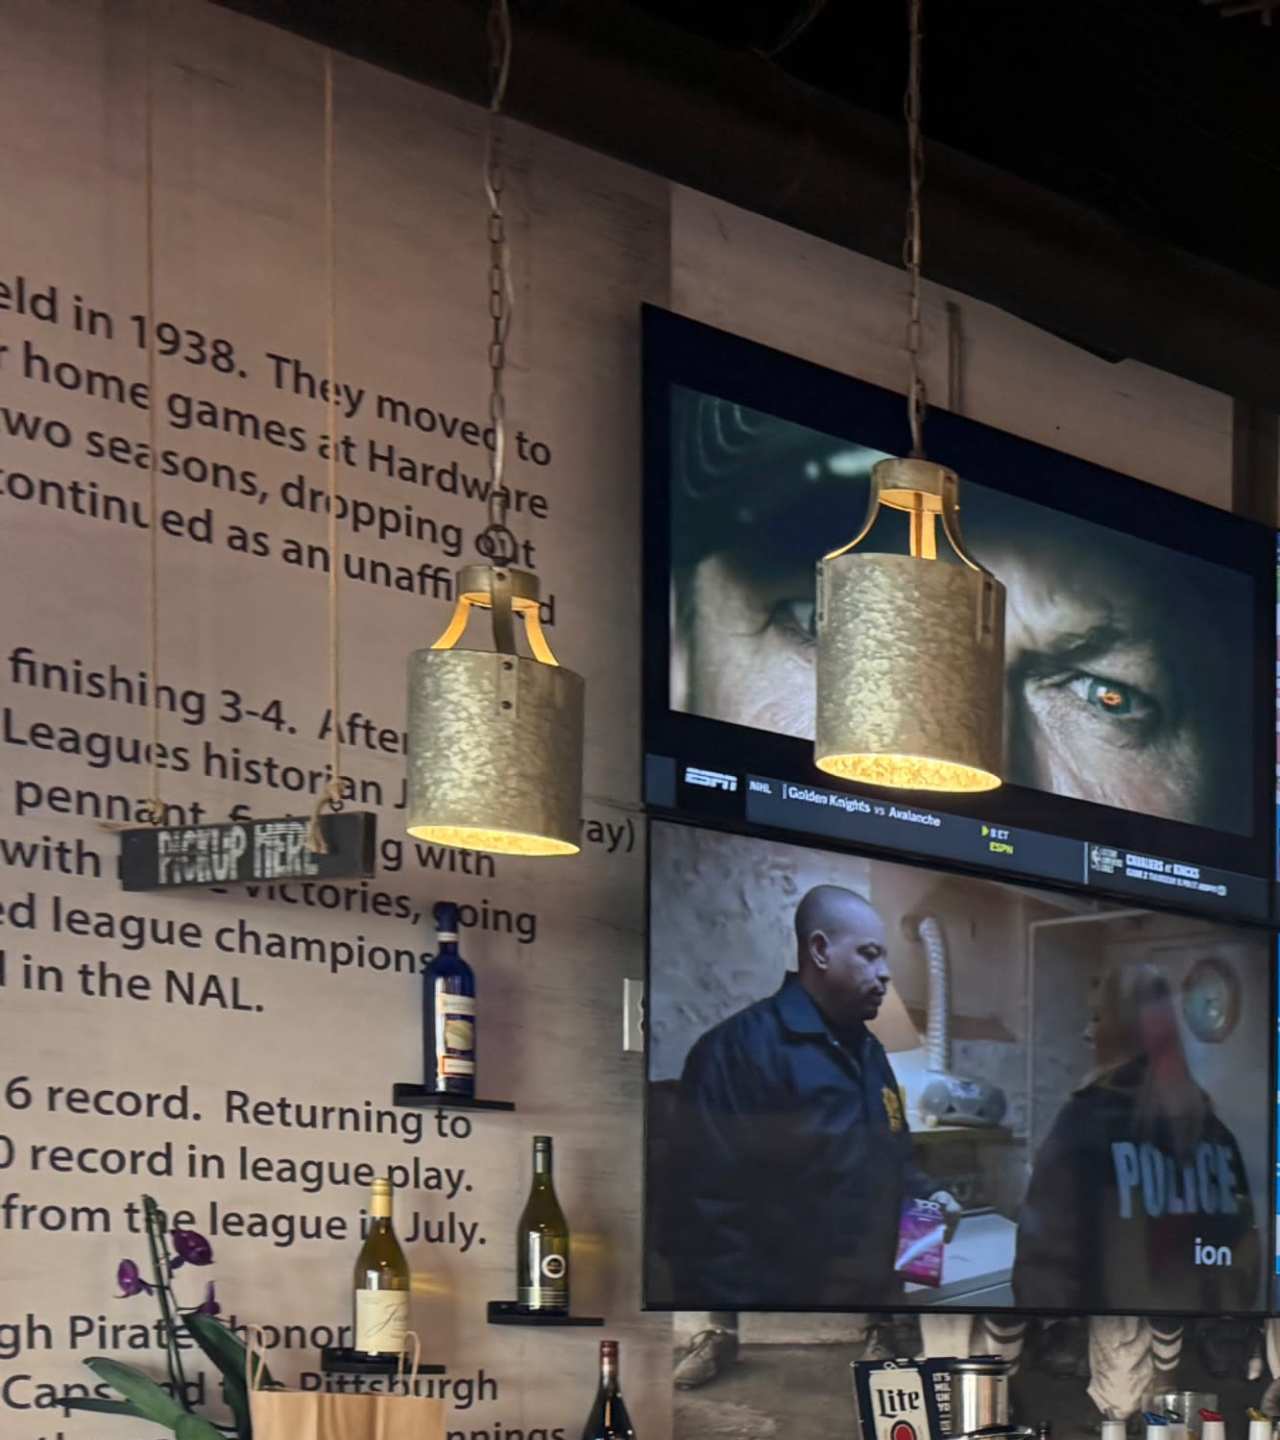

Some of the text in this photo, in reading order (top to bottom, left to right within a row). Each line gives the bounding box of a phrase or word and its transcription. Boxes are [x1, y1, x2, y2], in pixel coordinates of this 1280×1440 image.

[73, 294, 113, 339] in
[130, 314, 247, 378] 1938.
[266, 352, 365, 418] They
[515, 431, 552, 466] to
[24, 340, 549, 518] home games at Hardware
[85, 430, 267, 504] seasons,
[281, 475, 463, 557] dropping
[227, 524, 269, 556] as
[282, 536, 330, 572] an
[8, 647, 297, 734] finishing 3-4.
[3, 707, 190, 768] Leagues
[204, 741, 382, 806] historian
[15, 779, 206, 828] pennant
[685, 767, 738, 792] ESPN
[788, 786, 827, 805] Golden
[828, 795, 871, 813] Knights
[888, 806, 942, 828] Avalanche
[0, 836, 101, 878] with
[415, 842, 495, 877] with
[53, 896, 202, 950] league
[23, 954, 264, 1013] in the NAL.
[47, 1085, 202, 1121] record.
[225, 1090, 423, 1144] Returning
[435, 1107, 472, 1138] to
[30, 1142, 473, 1199] record in league play.
[1112, 1140, 1239, 1219] POLICE
[0, 1192, 111, 1232] from
[210, 1201, 346, 1247] league
[404, 1211, 486, 1252] July.
[1194, 1237, 1232, 1266] ion
[876, 1388, 919, 1419] Lite
